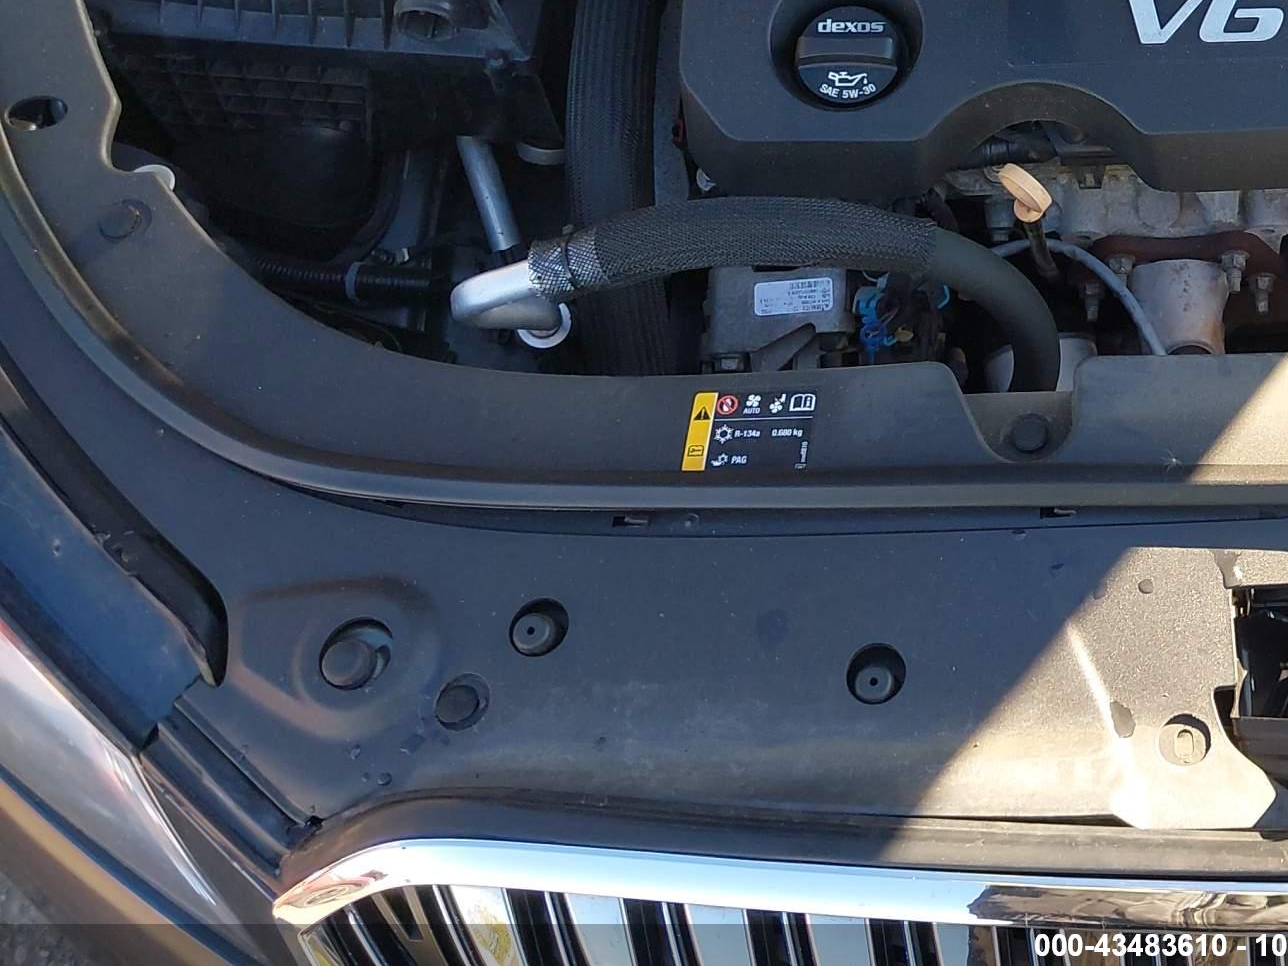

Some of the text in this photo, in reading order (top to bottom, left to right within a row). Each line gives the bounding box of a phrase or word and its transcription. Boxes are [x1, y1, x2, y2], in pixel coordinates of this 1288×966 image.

[817, 18, 888, 33] dexos
[819, 83, 877, 99] SAE 5W-30
[733, 429, 761, 438] R-134a
[793, 428, 803, 438] kg
[730, 454, 747, 465] PAG
